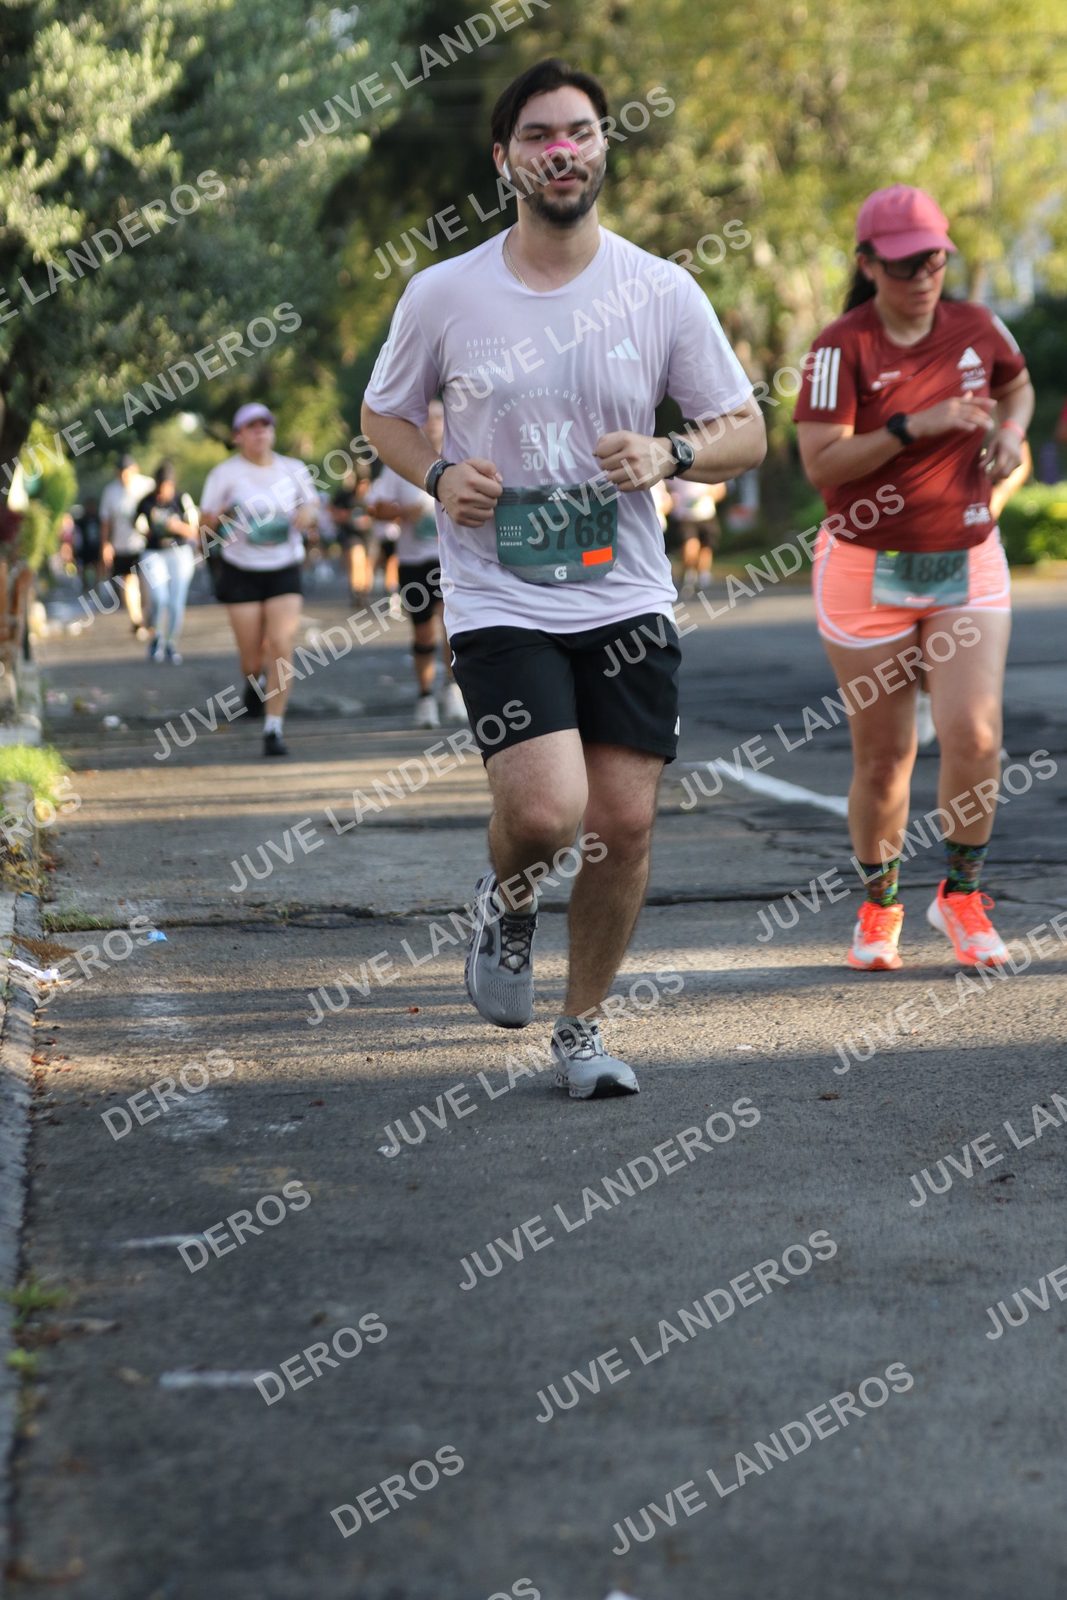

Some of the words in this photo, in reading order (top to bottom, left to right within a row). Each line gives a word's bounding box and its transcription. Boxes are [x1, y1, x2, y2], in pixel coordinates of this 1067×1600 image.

[519, 423, 541, 444] 15
[546, 420, 577, 470] K
[521, 452, 545, 472] 30
